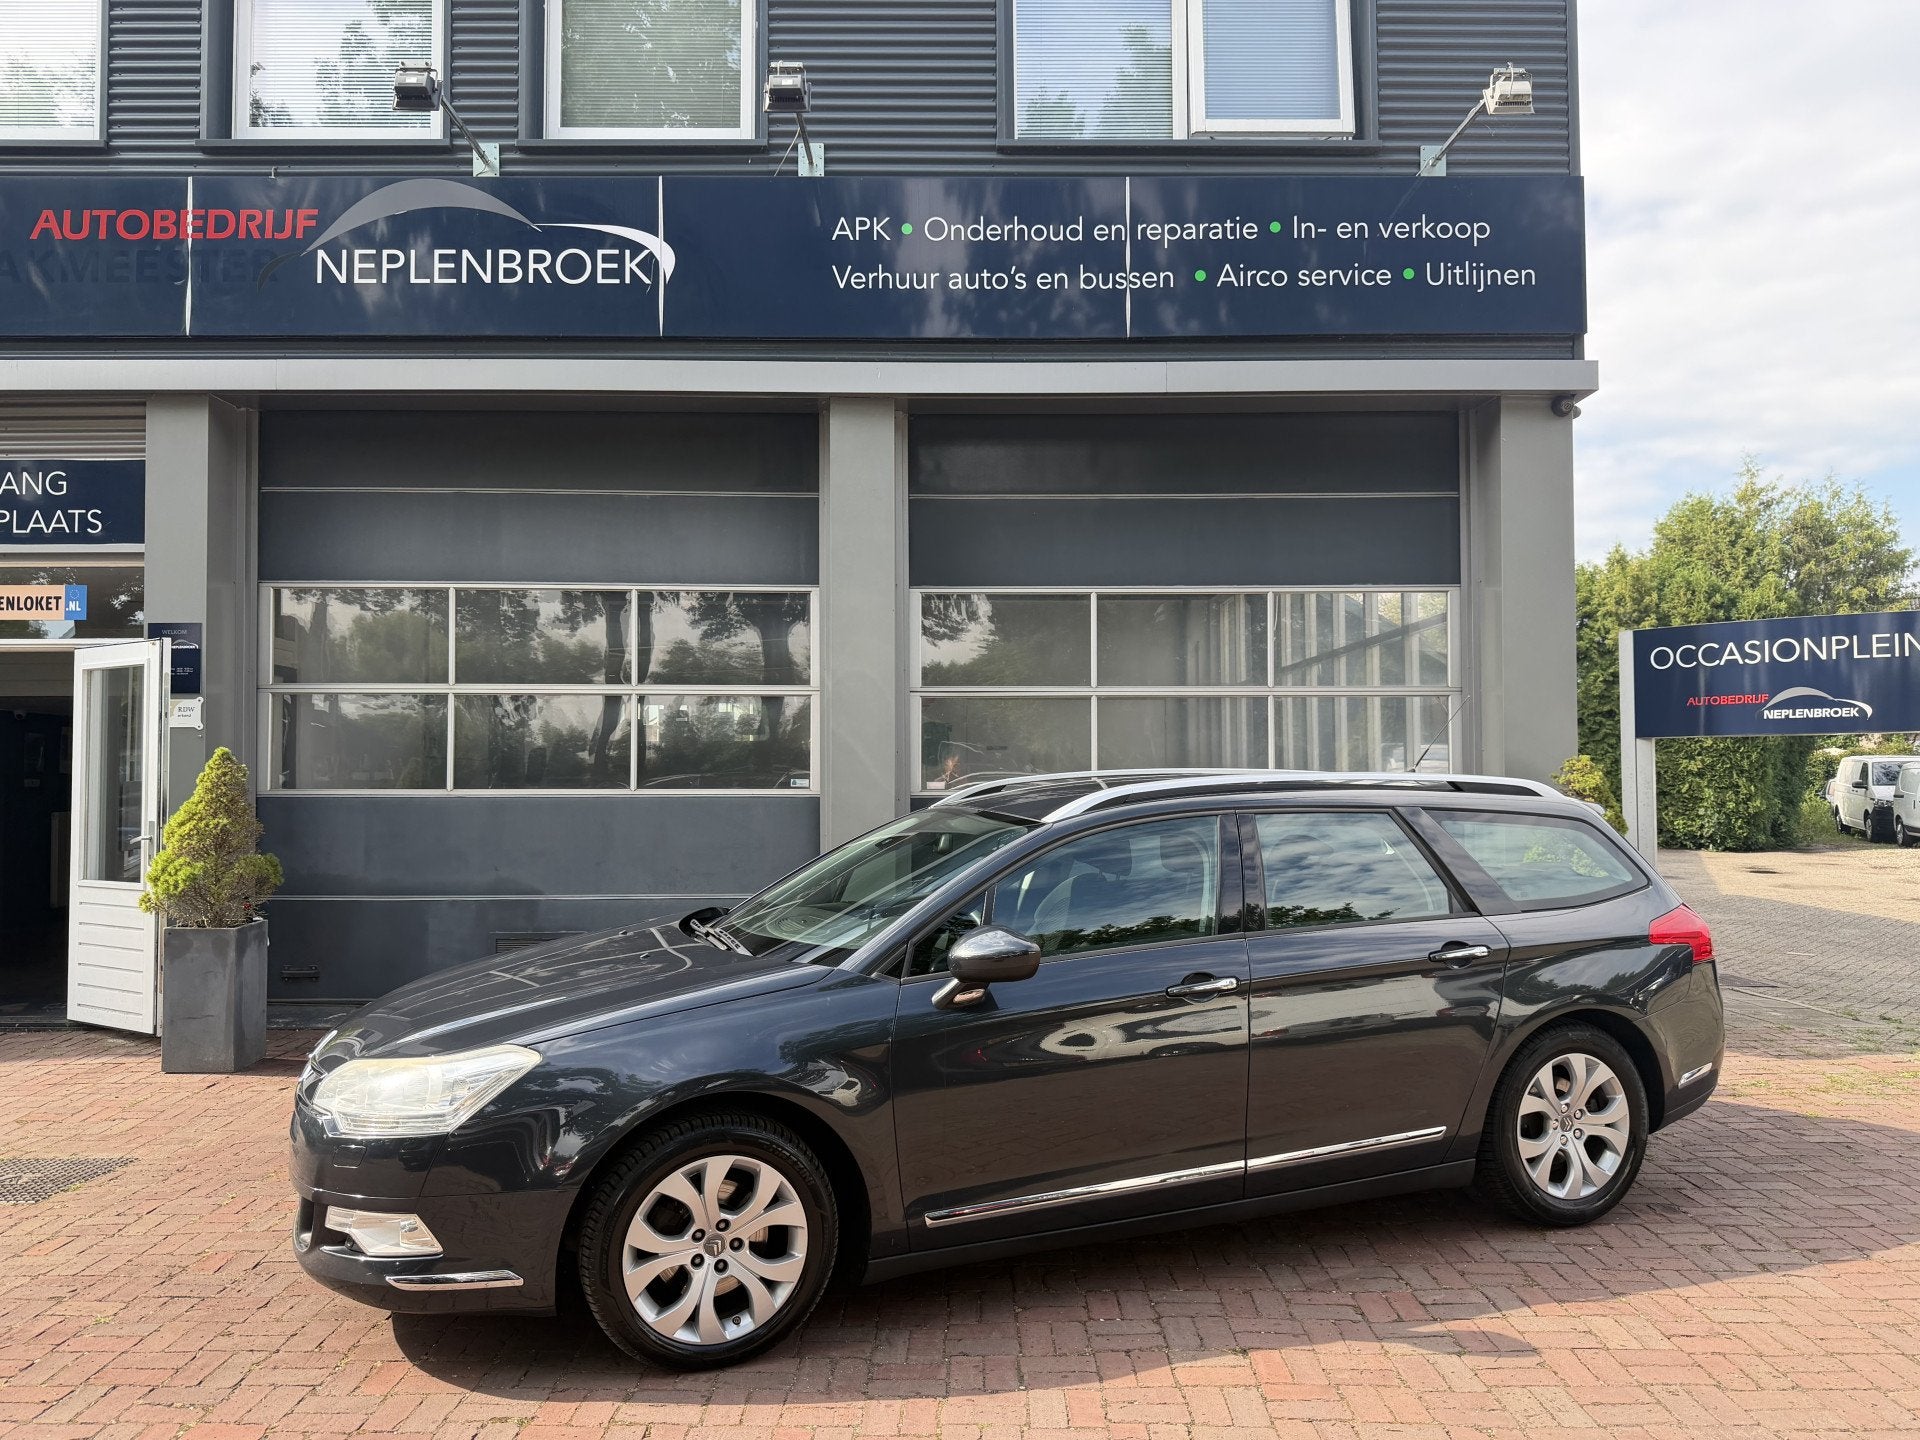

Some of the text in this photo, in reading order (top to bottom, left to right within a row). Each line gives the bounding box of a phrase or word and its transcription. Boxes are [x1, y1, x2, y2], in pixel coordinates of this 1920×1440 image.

[30, 209, 319, 240] AUTOBEDRIJF
[831, 213, 1492, 250] APK Onderhoud en reparatie In- en verkoop
[316, 248, 652, 285] NEPLENBROEK
[831, 262, 940, 290] Verhuur
[1036, 272, 1069, 290] en
[1079, 264, 1175, 289] bussen
[1216, 263, 1288, 287] Airco
[1297, 262, 1393, 287] service
[1425, 259, 1537, 293] Uitlijnen
[0, 471, 68, 496] ANG
[0, 509, 103, 534] PLAATS
[1650, 632, 1920, 670] OCCASIONPLEIN
[1687, 693, 1769, 706] AUTOBEDRIJF
[1763, 706, 1860, 720] NEPLENBROEK
